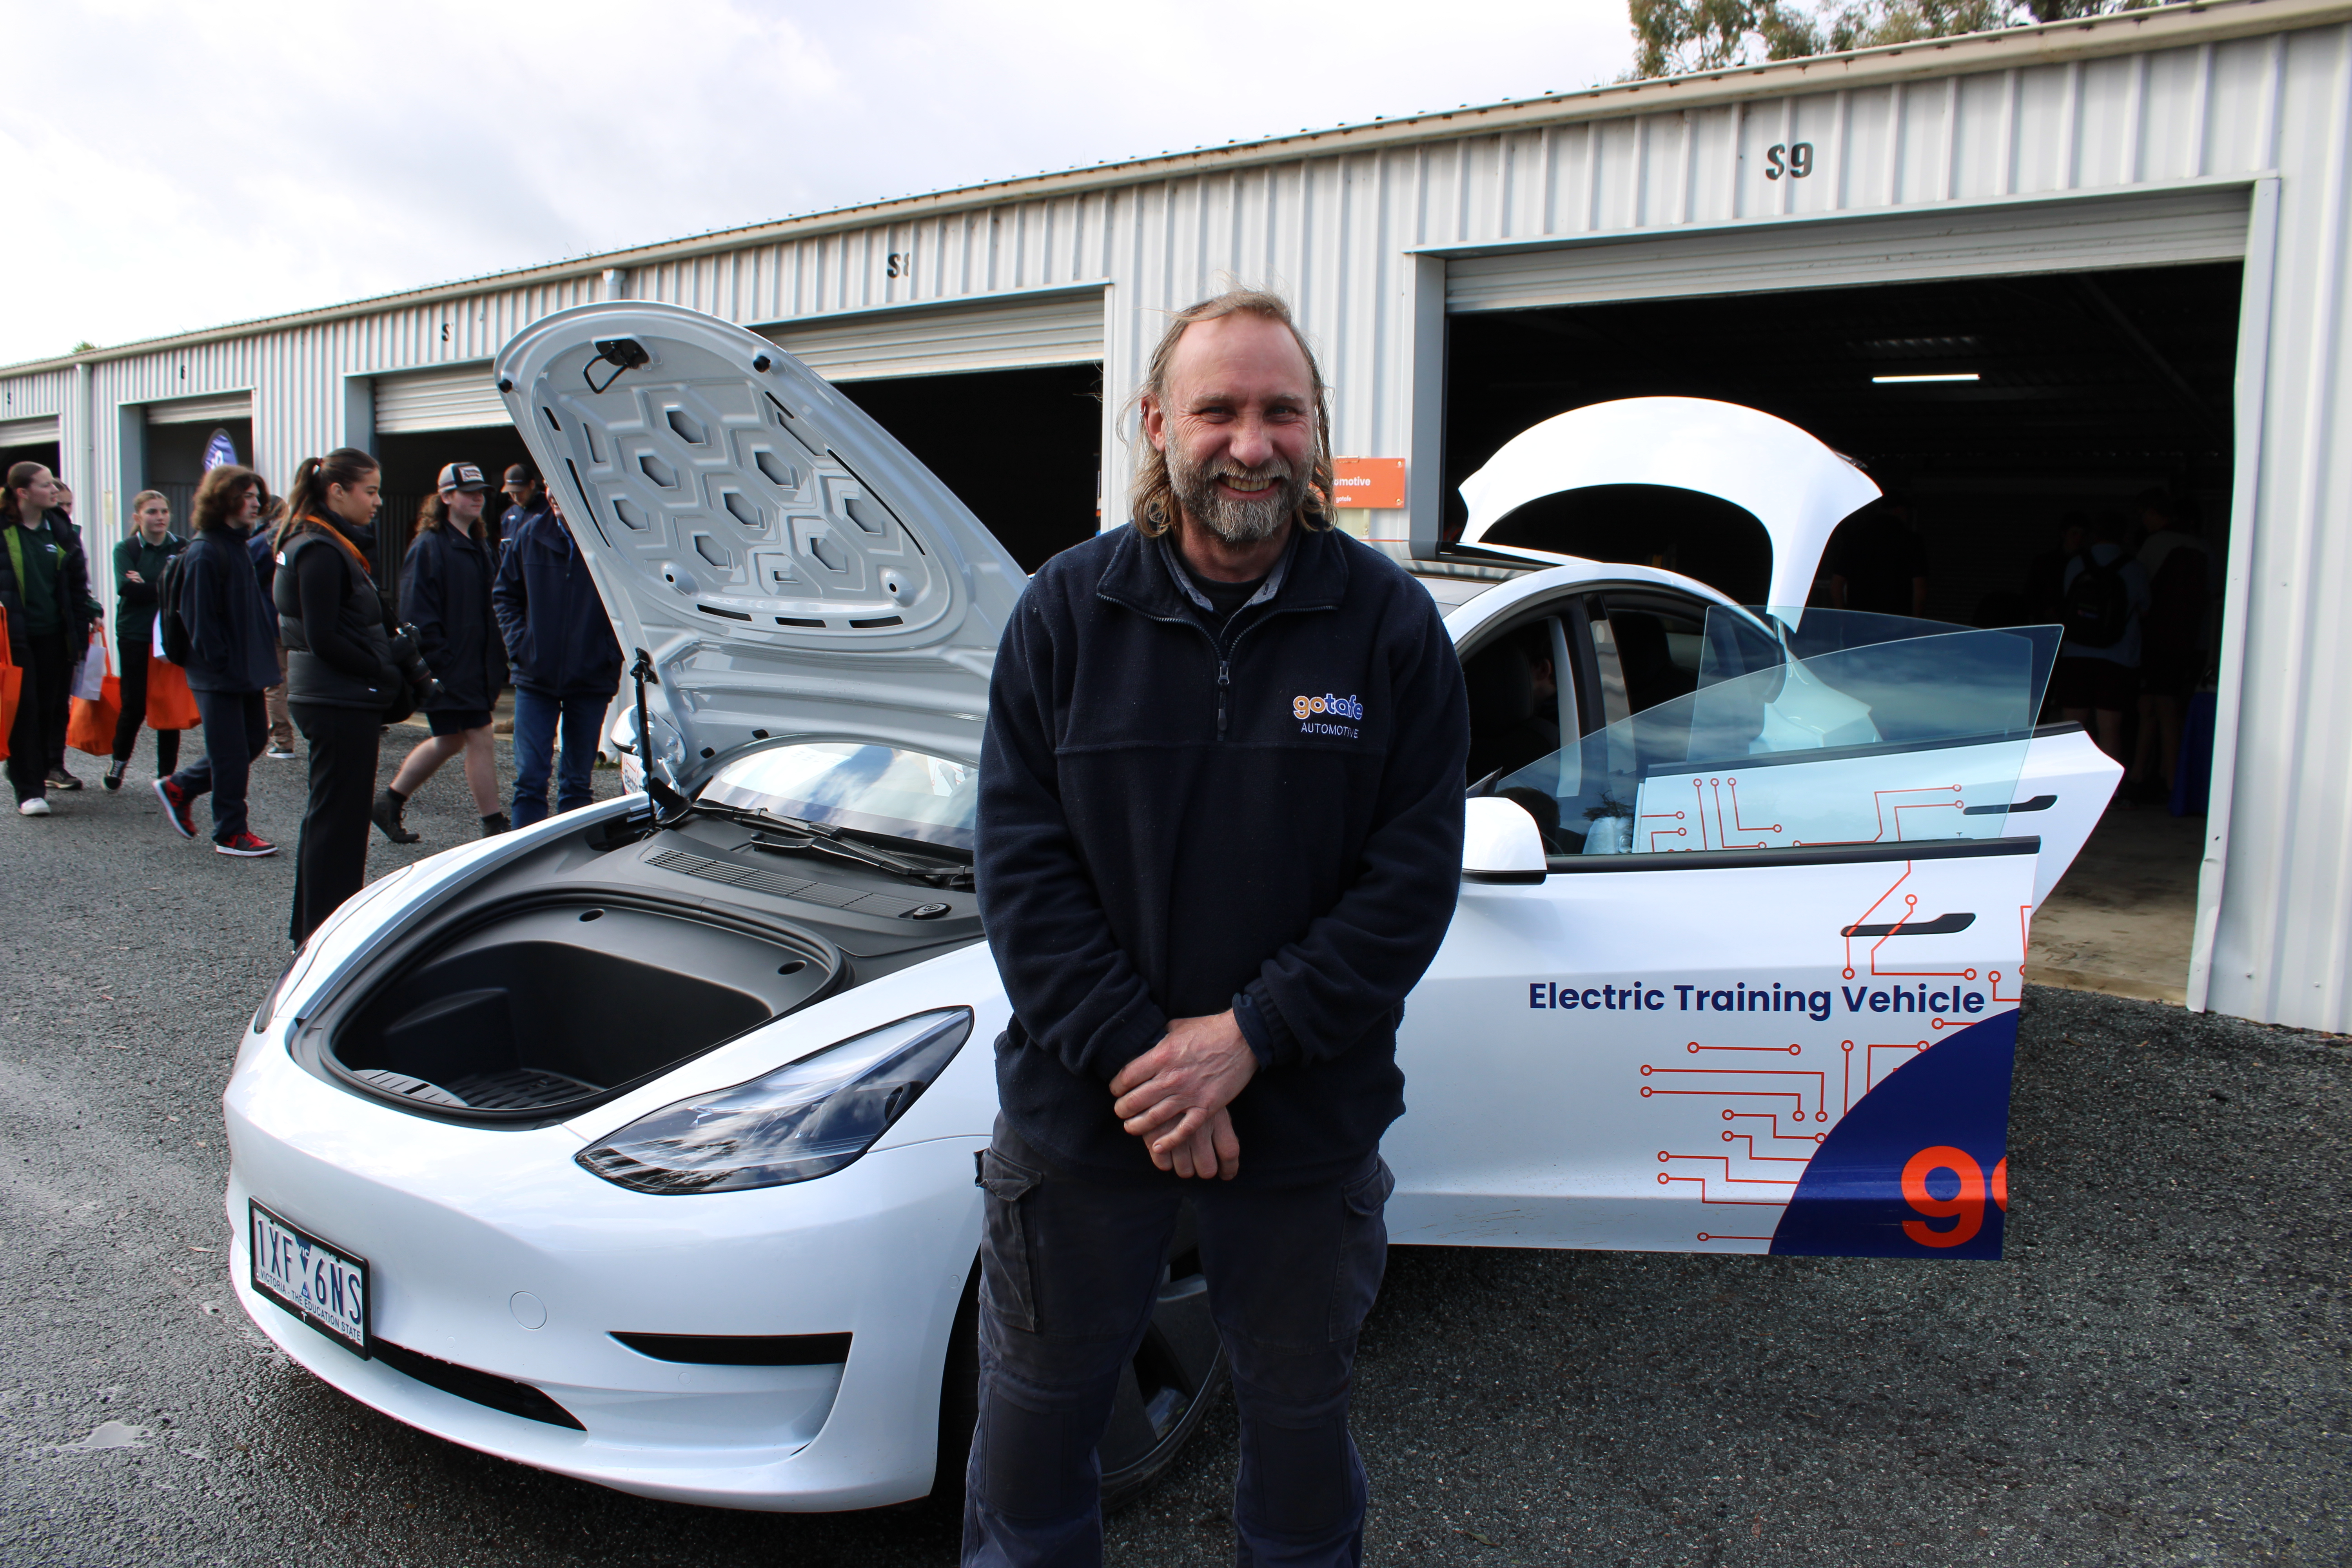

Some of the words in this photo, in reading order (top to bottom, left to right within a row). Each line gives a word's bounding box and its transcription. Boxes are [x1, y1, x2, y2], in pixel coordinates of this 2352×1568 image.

[1766, 142, 1814, 180] S9
[1332, 476, 1371, 486] omotive
[1293, 693, 1363, 720] gotafe
[1301, 722, 1359, 739] AUTOMOTIVE
[1530, 981, 1665, 1011] Electric
[1673, 982, 1831, 1022] Training
[1841, 983, 1985, 1013] Vehicle
[258, 1218, 293, 1284] 1XF
[315, 1257, 362, 1325] 6NS
[260, 1269, 287, 1294] VICTORIA
[291, 1290, 303, 1305] THE
[305, 1299, 339, 1328] EDUCATION
[341, 1321, 361, 1341] STATE
